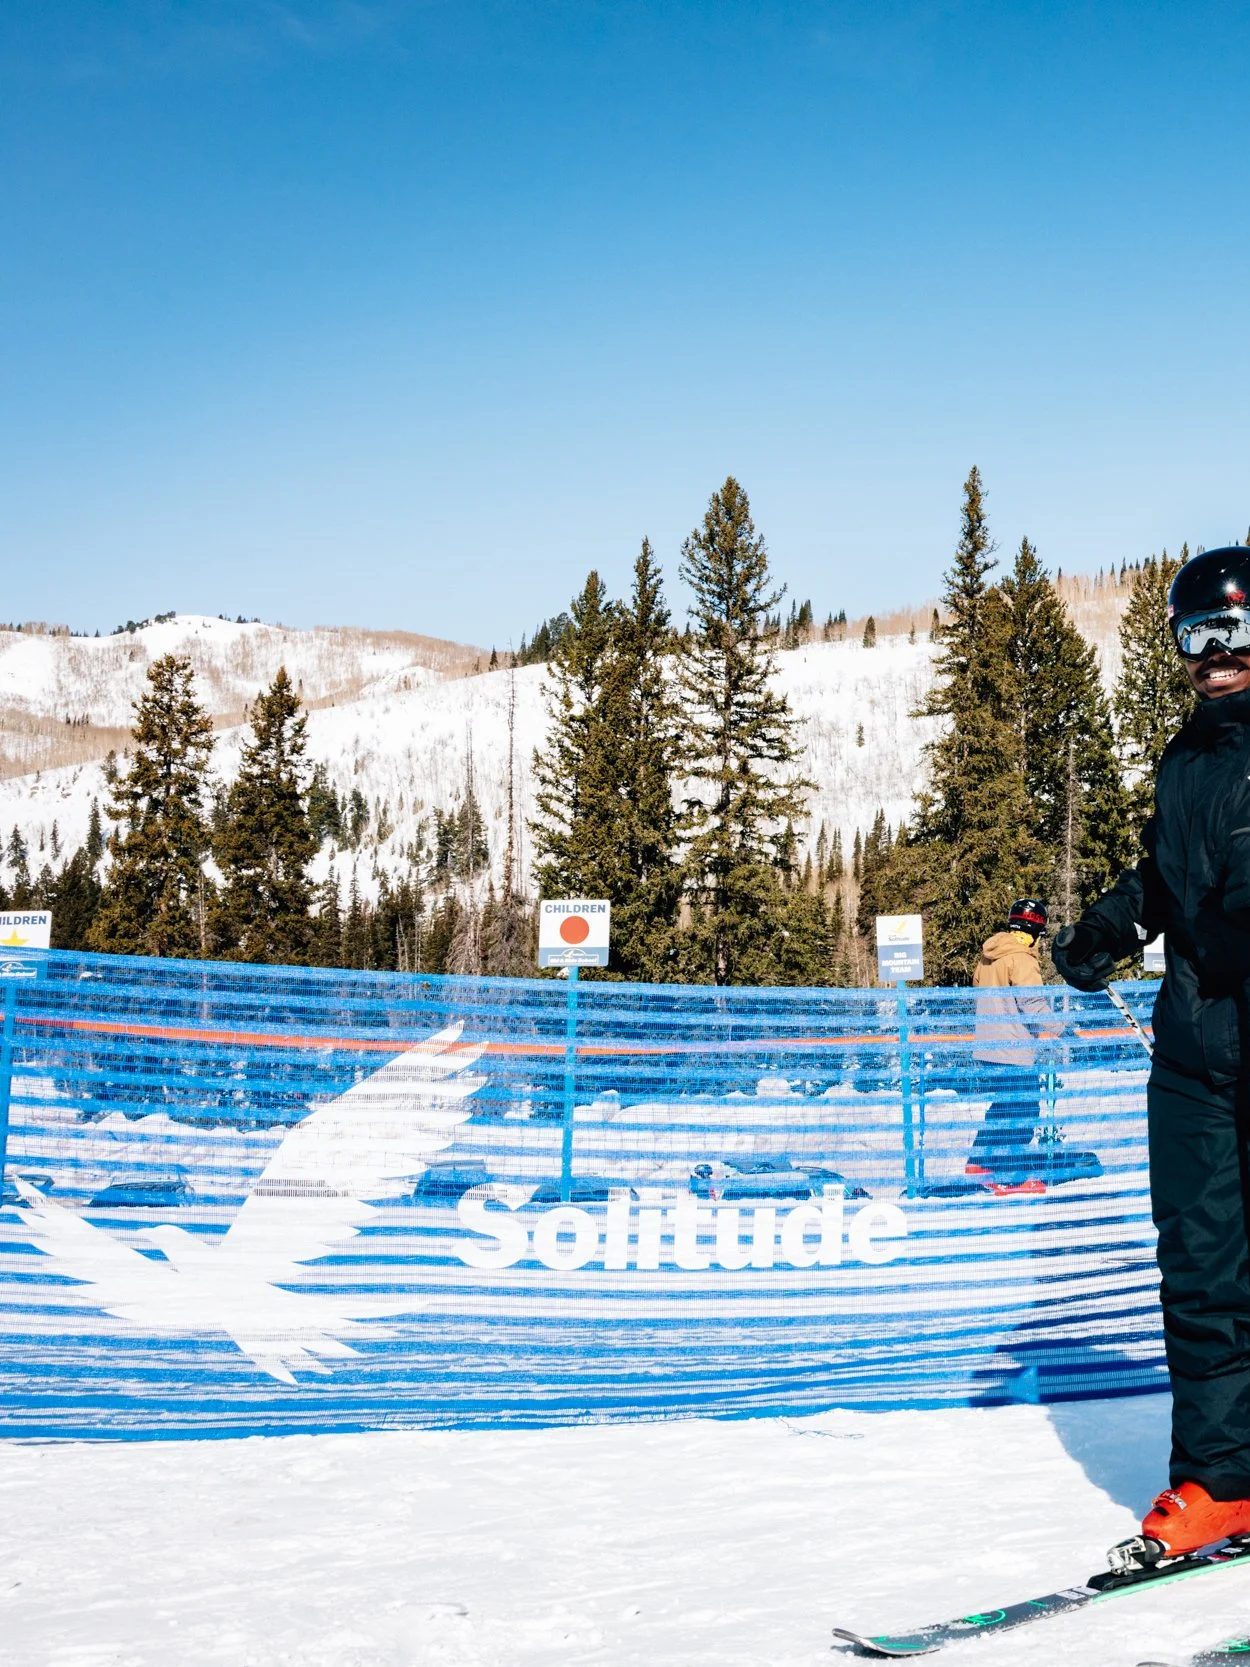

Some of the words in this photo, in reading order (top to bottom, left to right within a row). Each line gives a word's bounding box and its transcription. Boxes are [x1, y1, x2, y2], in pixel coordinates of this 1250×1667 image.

[544, 904, 606, 913] CHILDREN
[0, 915, 47, 925] ILDREN
[454, 1182, 909, 1270] Solitude
